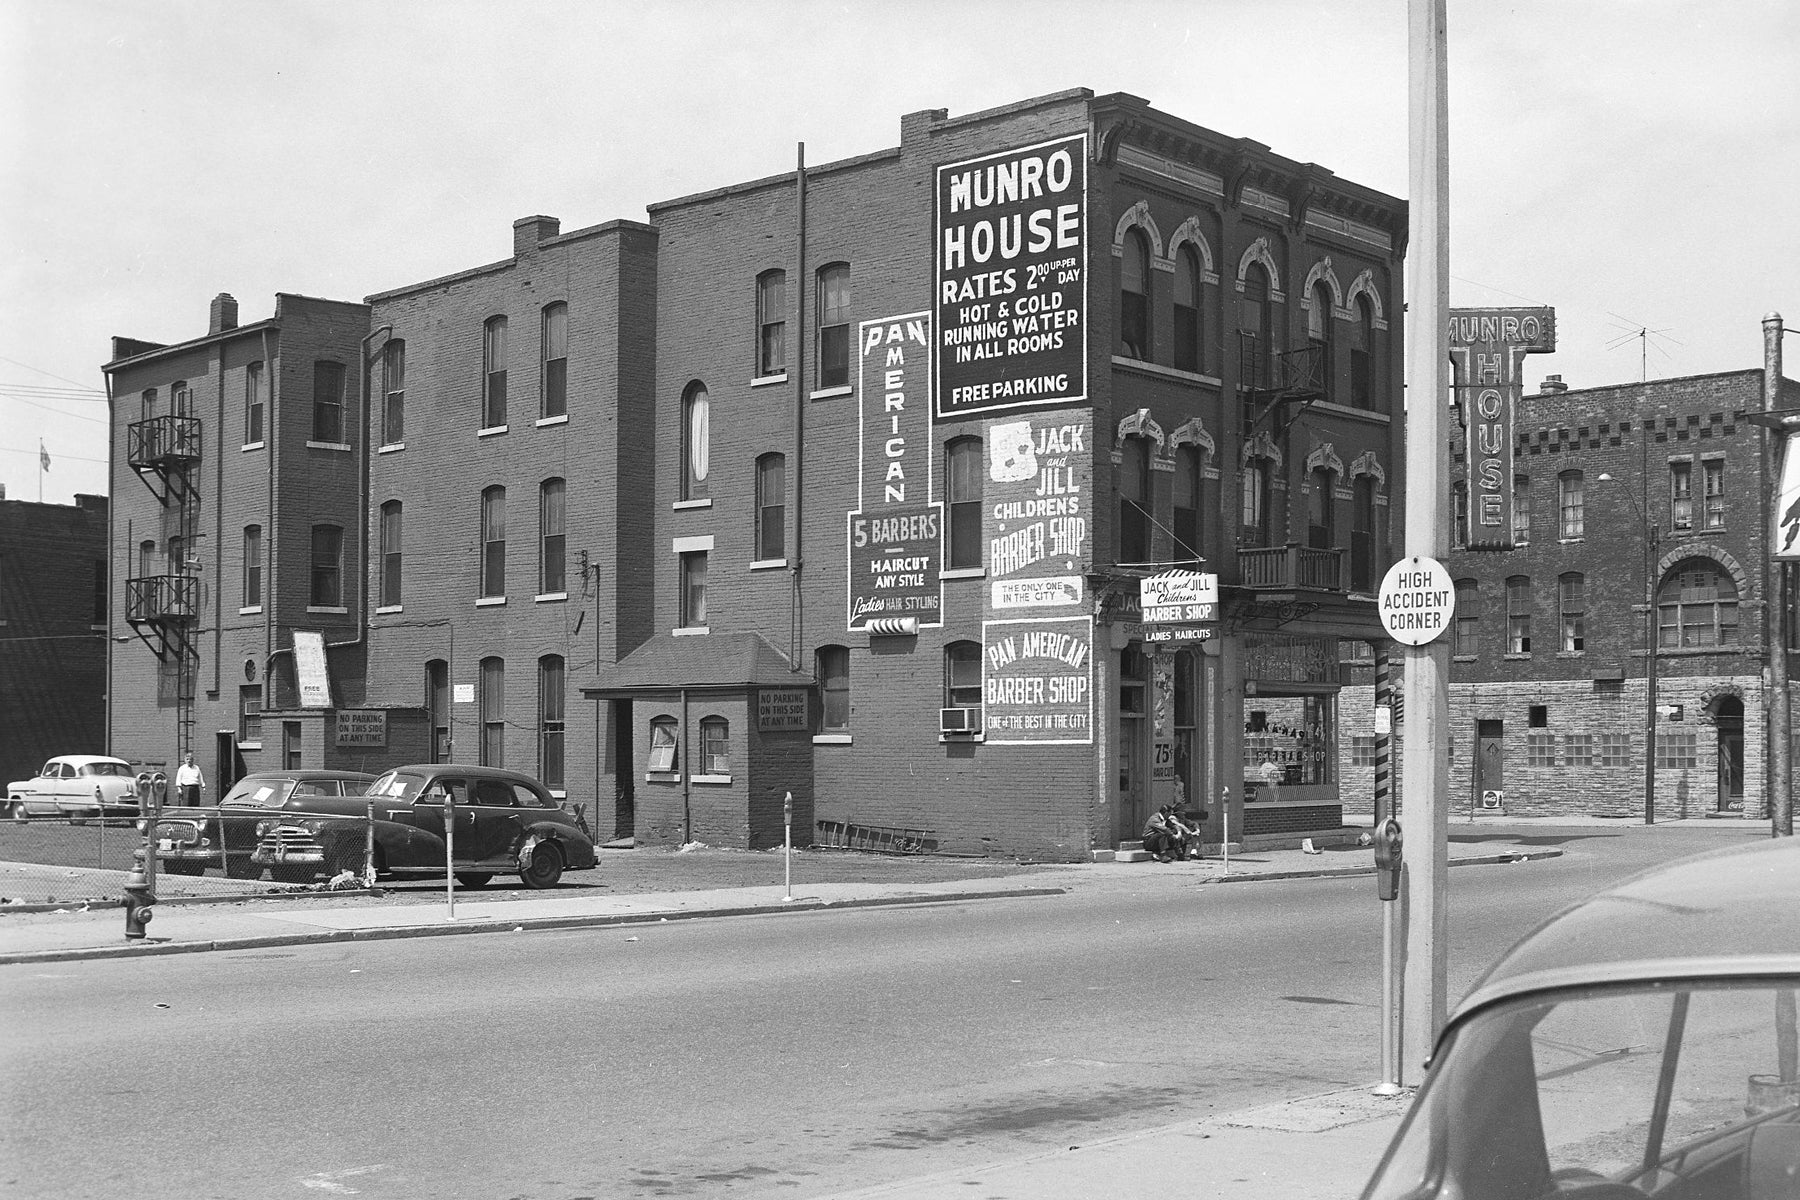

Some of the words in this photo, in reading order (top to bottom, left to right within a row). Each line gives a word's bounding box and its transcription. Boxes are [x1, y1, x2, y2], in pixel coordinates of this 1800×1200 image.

[950, 150, 1072, 213] MUNRO
[945, 204, 1078, 270] HOUSE
[1058, 268, 1080, 284] DAY
[942, 268, 1016, 304] RATES
[960, 304, 990, 324] HOT
[998, 302, 1009, 318] &
[1015, 292, 1062, 315] COLD
[944, 320, 1008, 346] RUNNING
[1012, 309, 1078, 335] WATER
[864, 320, 926, 356] PAN
[956, 346, 971, 363] IN
[974, 341, 1004, 360] ALL
[1008, 331, 1064, 356] ROOMS
[952, 384, 990, 404] FREE
[992, 374, 1068, 398] PARKING
[1035, 424, 1084, 455] JACK
[1478, 354, 1502, 525] HOUSE
[1046, 456, 1068, 468] and
[1036, 466, 1080, 496] JILL
[994, 496, 1079, 520] CHILDREN'S
[854, 520, 868, 548] 5
[872, 514, 937, 543] BARBERS
[991, 522, 1045, 577] BARBER
[1050, 516, 1086, 557] SHOP
[870, 557, 930, 573] HAIRCUT
[875, 575, 896, 588] ANY
[898, 574, 924, 586] STYLE
[1002, 584, 1020, 592] THE
[1022, 583, 1044, 592] ONLY
[1046, 582, 1063, 590] ONE
[1144, 580, 1170, 594] JACK
[1172, 578, 1191, 590] and
[1190, 578, 1210, 591] JILL
[1399, 572, 1432, 588] HIGH
[1003, 594, 1012, 602] IN
[1014, 593, 1030, 602] THE
[1034, 592, 1056, 600] CITY
[1119, 595, 1141, 612] JAC
[1384, 591, 1449, 610] ACCIDENT
[850, 596, 884, 623] Ladies
[886, 598, 902, 610] HAIR
[906, 596, 938, 610] STYLING
[1144, 606, 1182, 622] BARBER
[1186, 604, 1212, 619] SHOP
[1390, 612, 1440, 630] CORNER
[1146, 632, 1172, 642] LADIES
[1175, 629, 1211, 640] HAIRCUTS
[988, 636, 1016, 670] PAN
[1022, 632, 1088, 668] AMERICAN
[761, 694, 771, 704] NO
[774, 694, 804, 703] PARKING
[988, 678, 1044, 704] BARBER
[1049, 676, 1086, 704] SHOP
[340, 714, 350, 722] NO
[352, 714, 382, 723] PARKING
[760, 706, 770, 715] ON
[773, 705, 788, 714] THIS
[790, 705, 804, 714] SIDE
[368, 724, 383, 732] SIDE
[762, 717, 770, 726] AT
[772, 716, 785, 726] ANY
[787, 716, 804, 725] TIME
[988, 716, 1002, 728] ONE
[1010, 716, 1022, 728] THE
[1024, 715, 1044, 728] BEST
[1046, 715, 1052, 728] IN
[1054, 714, 1068, 728] THE
[1070, 714, 1086, 728] CITY
[340, 734, 350, 742] AT
[350, 734, 363, 742] ANY
[364, 734, 382, 742] TIME
[1303, 752, 1326, 762] SHOP
